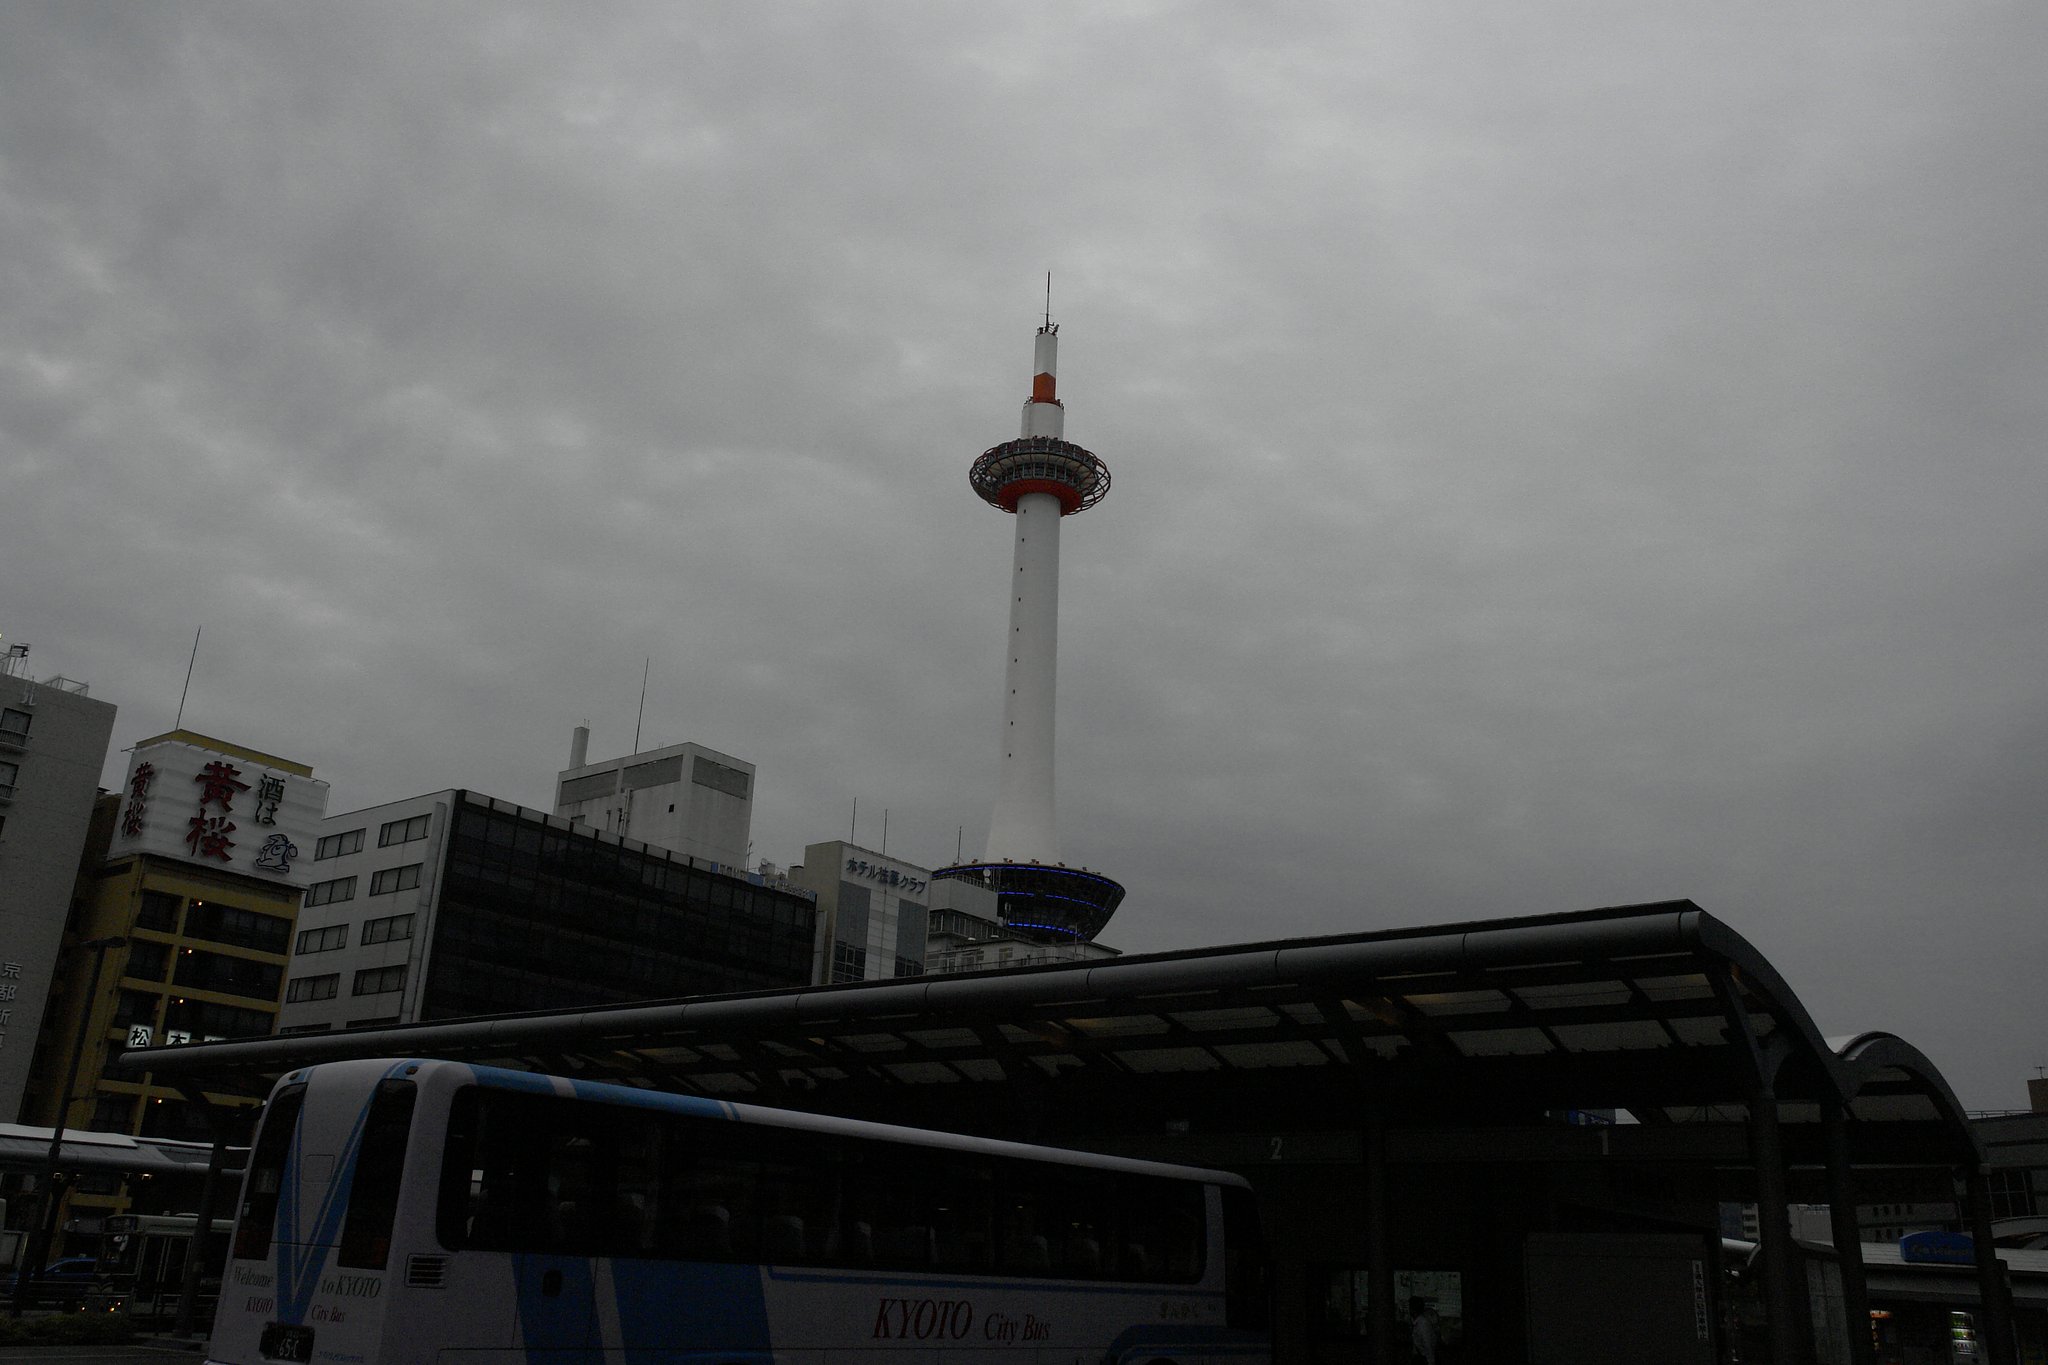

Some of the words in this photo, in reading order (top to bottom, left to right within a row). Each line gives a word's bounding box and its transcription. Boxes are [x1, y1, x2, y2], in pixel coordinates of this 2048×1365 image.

[186, 760, 252, 862] 黄桜
[255, 773, 285, 826] 酒は
[1270, 1136, 1283, 1160] 2
[234, 1265, 274, 1288] Welcome
[321, 1278, 334, 1295] to
[335, 1275, 382, 1298] KYOTO
[245, 1296, 274, 1313] KYOTO
[329, 1307, 346, 1323] Bus
[872, 1298, 973, 1340] KYOTO
[984, 1312, 1018, 1346] City
[1022, 1313, 1051, 1342] Bus
